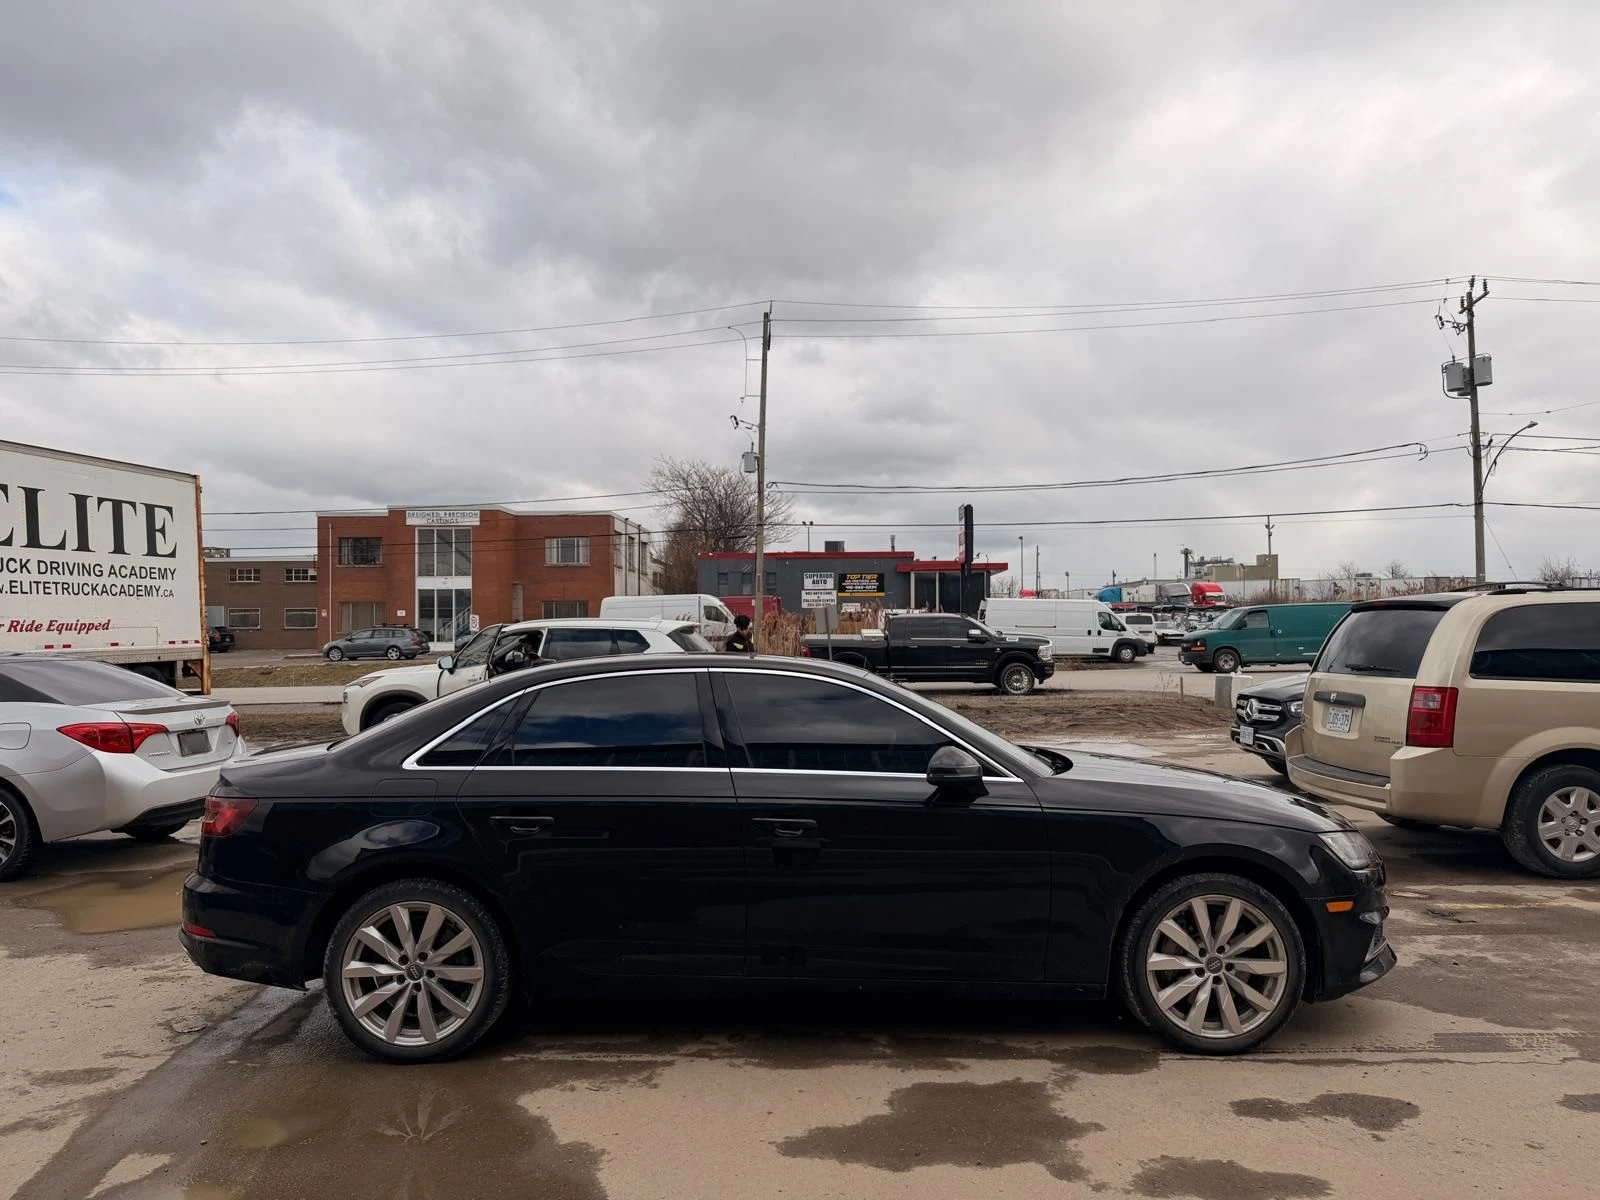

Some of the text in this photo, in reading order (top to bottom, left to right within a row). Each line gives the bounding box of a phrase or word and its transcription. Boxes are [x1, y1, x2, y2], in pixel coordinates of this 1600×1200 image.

[37, 560, 104, 577] DRIVING
[108, 564, 177, 581] ACADEMY
[6, 618, 43, 633] Ride
[46, 618, 111, 635] Equipped
